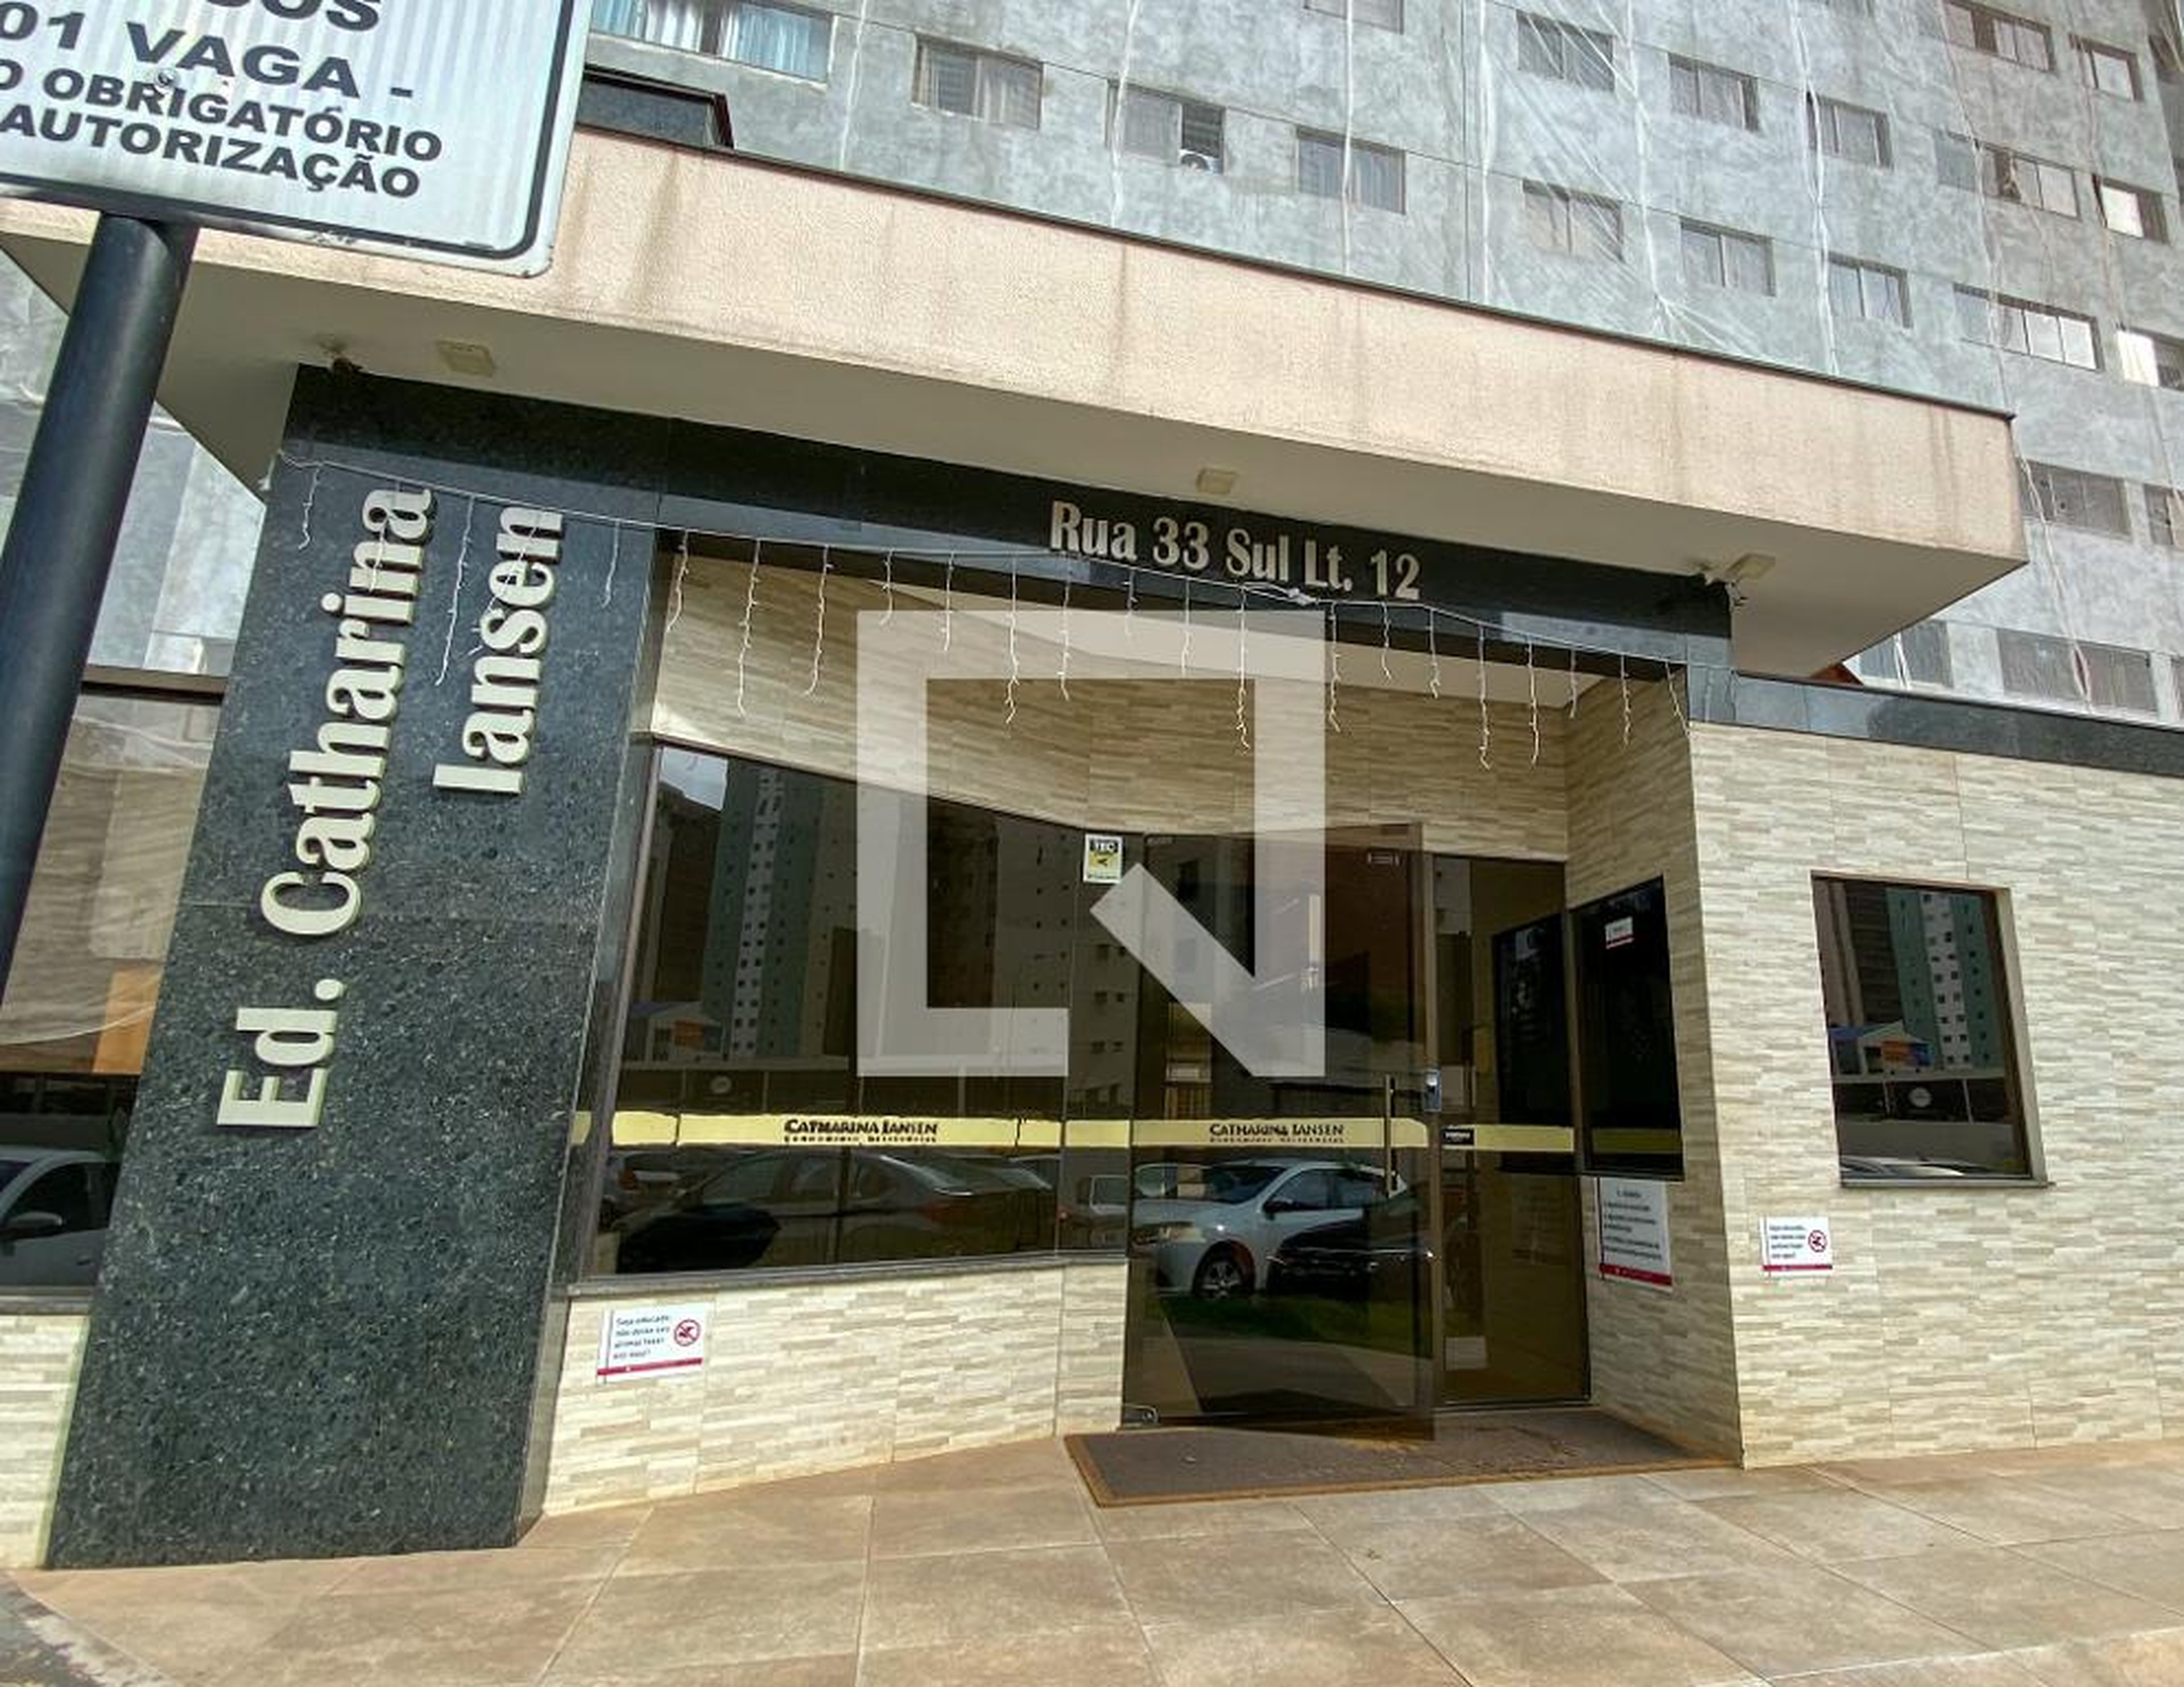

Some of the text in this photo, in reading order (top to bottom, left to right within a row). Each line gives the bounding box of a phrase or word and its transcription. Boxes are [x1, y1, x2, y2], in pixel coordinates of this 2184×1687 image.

[0, 2, 84, 49] 01
[126, 22, 360, 98] VAGA
[207, 0, 379, 31] OS
[0, 103, 419, 197] AUTORIZAÇÃO
[43, 68, 442, 161] OBRIGATÓRIO
[1050, 500, 1421, 600] Rua 33 Sul Lt. 12
[217, 487, 434, 1128] Ed. Catharina
